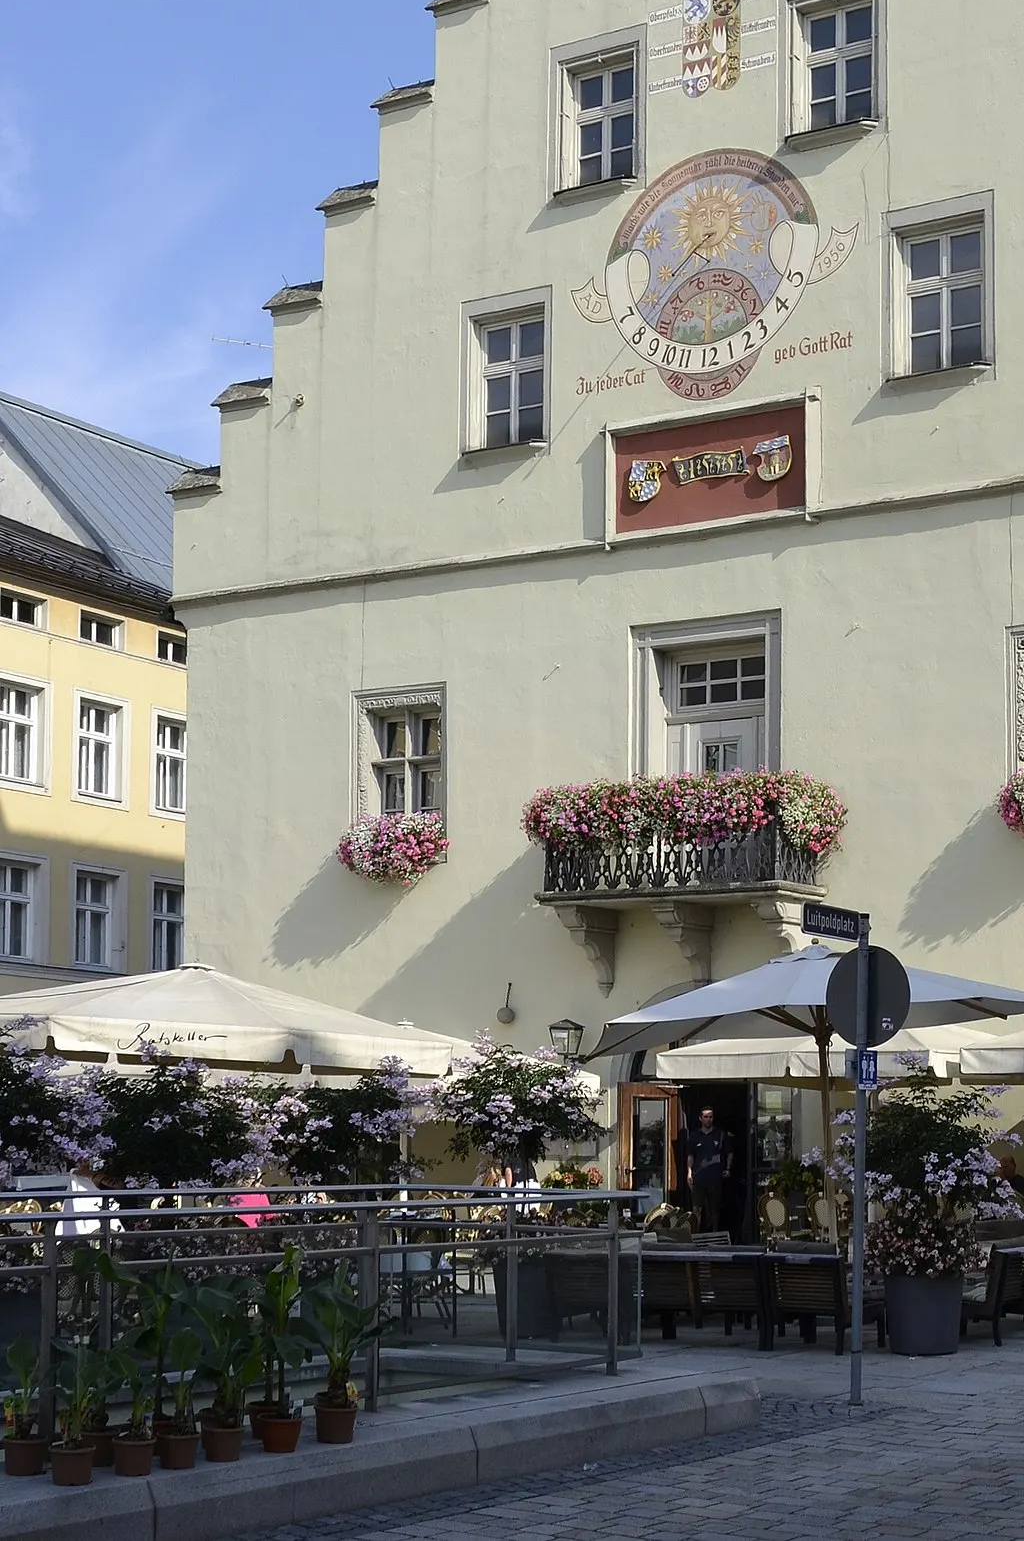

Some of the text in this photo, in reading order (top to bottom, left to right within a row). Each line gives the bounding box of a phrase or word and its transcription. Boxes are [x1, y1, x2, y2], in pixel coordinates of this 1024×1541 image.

[638, 201, 650, 216] wie
[648, 189, 661, 202] die
[661, 161, 702, 190] Sonnenuhr
[723, 154, 736, 166] die
[736, 156, 763, 174] heiteren
[763, 166, 790, 195] Stunden
[788, 193, 800, 208] nur
[817, 240, 845, 274] 1956
[580, 293, 602, 314] AD
[619, 268, 804, 368] 7 8 9 10 11 12 1 2 3 4 5
[774, 331, 853, 364] geb Gott Rat
[576, 367, 646, 396] Zu jeder Tat
[806, 908, 855, 934] Luitpoldplatz
[117, 1022, 228, 1050] Ratskeller
